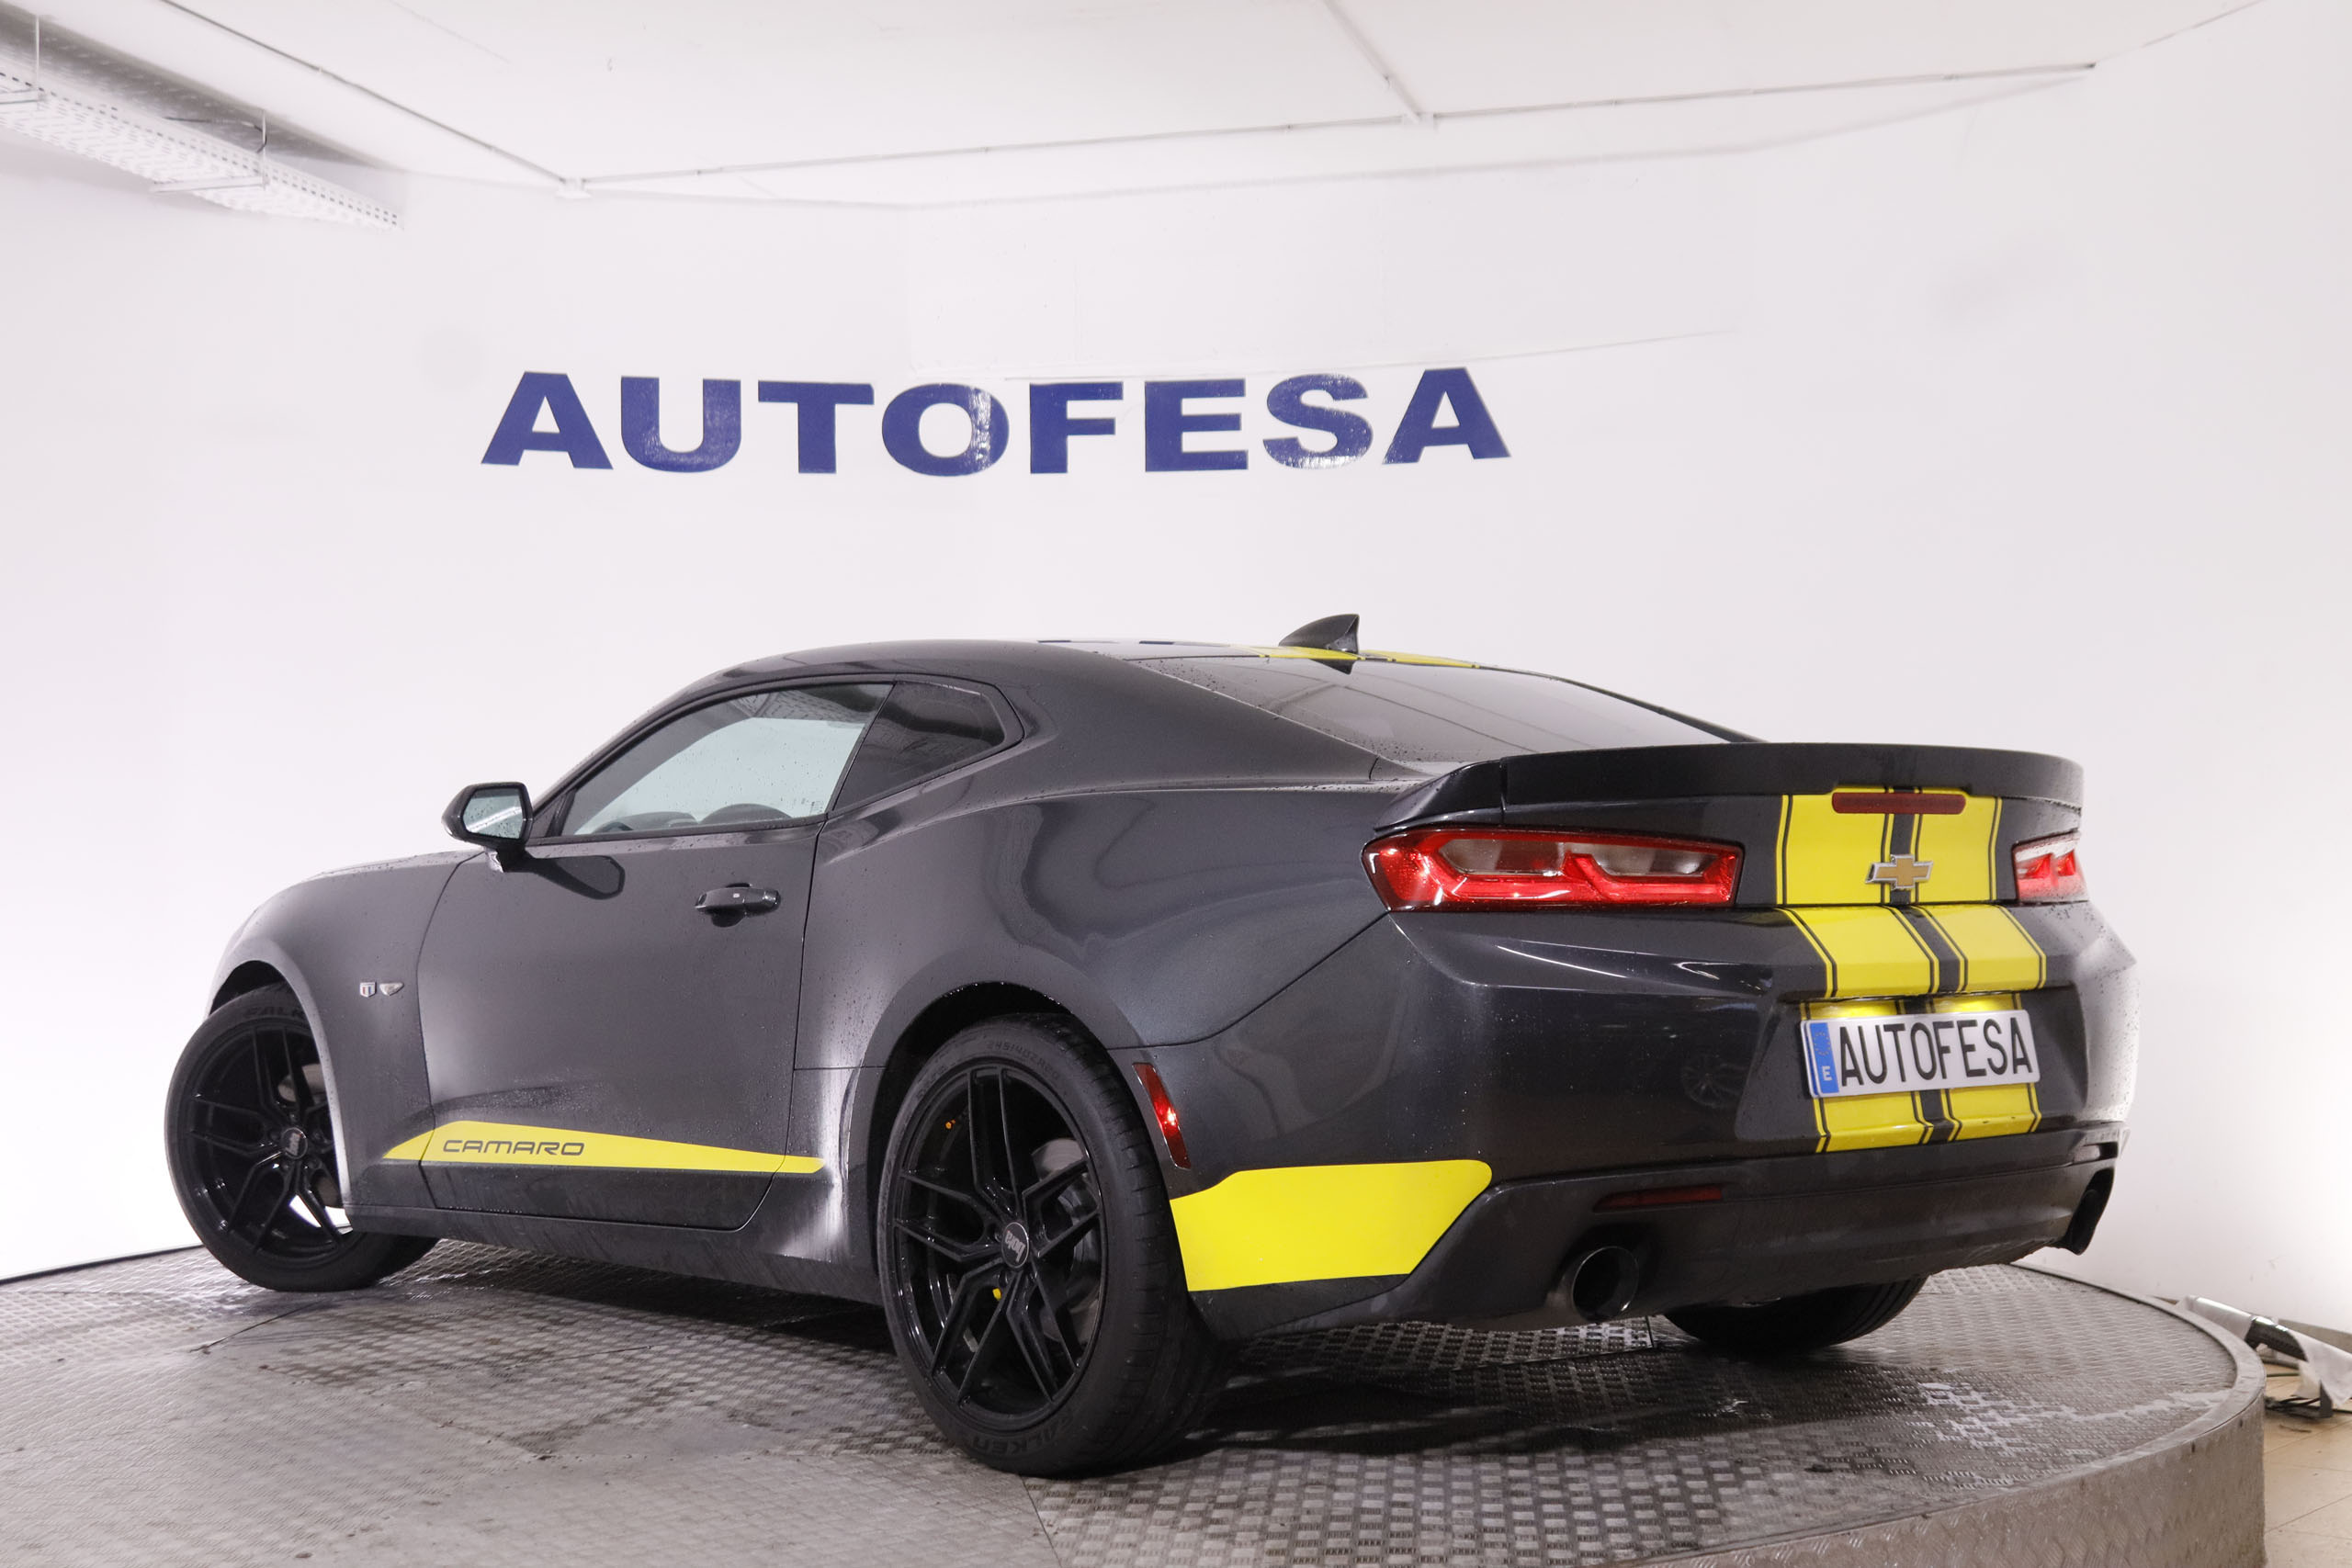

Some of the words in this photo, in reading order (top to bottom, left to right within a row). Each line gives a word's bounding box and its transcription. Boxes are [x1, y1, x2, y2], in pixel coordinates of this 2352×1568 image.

[481, 367, 1511, 477] AUTOFESA
[1839, 1017, 2033, 1087] AUTOFESA
[1822, 1066, 1833, 1082] E
[443, 1140, 585, 1156] CAMARO
